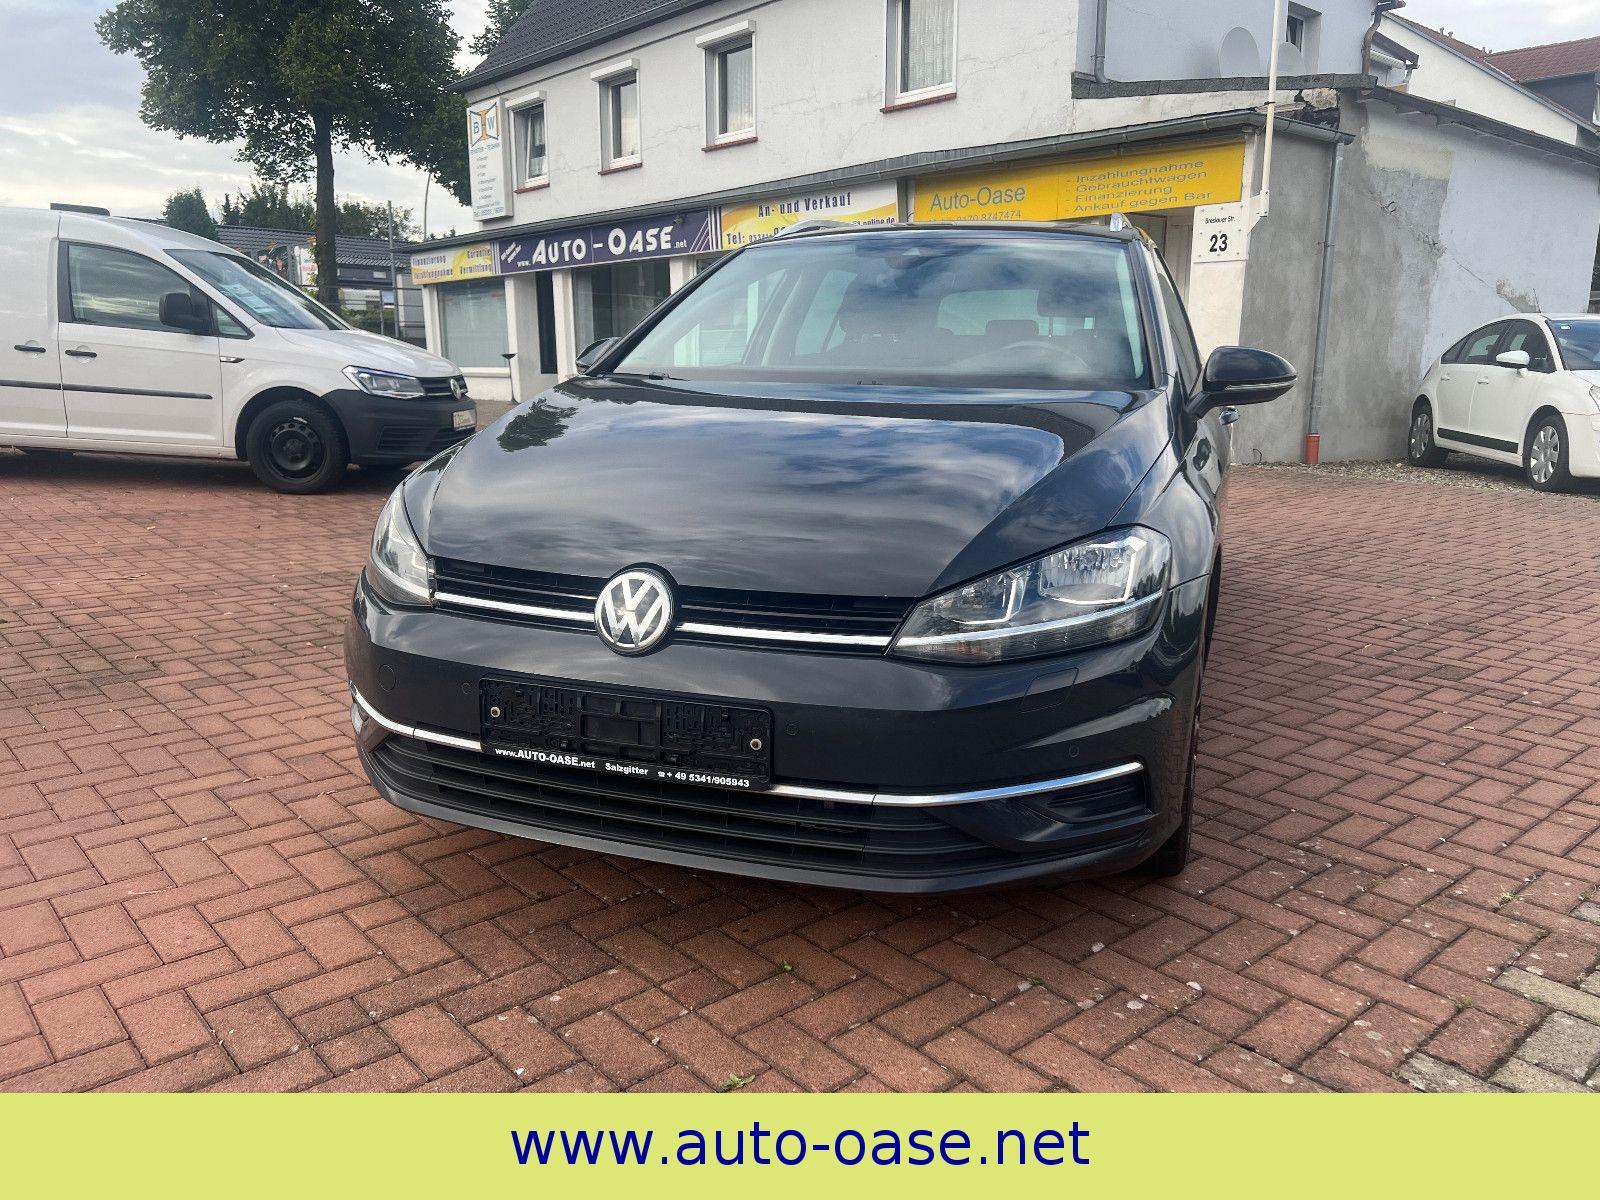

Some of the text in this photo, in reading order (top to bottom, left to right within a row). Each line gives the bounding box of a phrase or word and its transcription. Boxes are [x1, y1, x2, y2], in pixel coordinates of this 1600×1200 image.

[1076, 160, 1205, 183] Inzahlungnahme
[1076, 171, 1207, 193] Gebrauchtwagen
[758, 192, 851, 217] An- und Verkauf
[930, 186, 1026, 212] Auto-Oase
[1072, 191, 1213, 213] Ankauf gegen Bar
[1075, 185, 1173, 203] Finanzierung
[1205, 217, 1228, 225] Breslauer
[674, 239, 687, 249] .net
[726, 232, 745, 245] Tel:
[1209, 233, 1228, 253] 23
[495, 748, 596, 769] www.AUTO-OASE.net
[605, 762, 649, 776] Salzgitter
[675, 771, 687, 781] 49
[688, 773, 750, 788] 5341/905943
